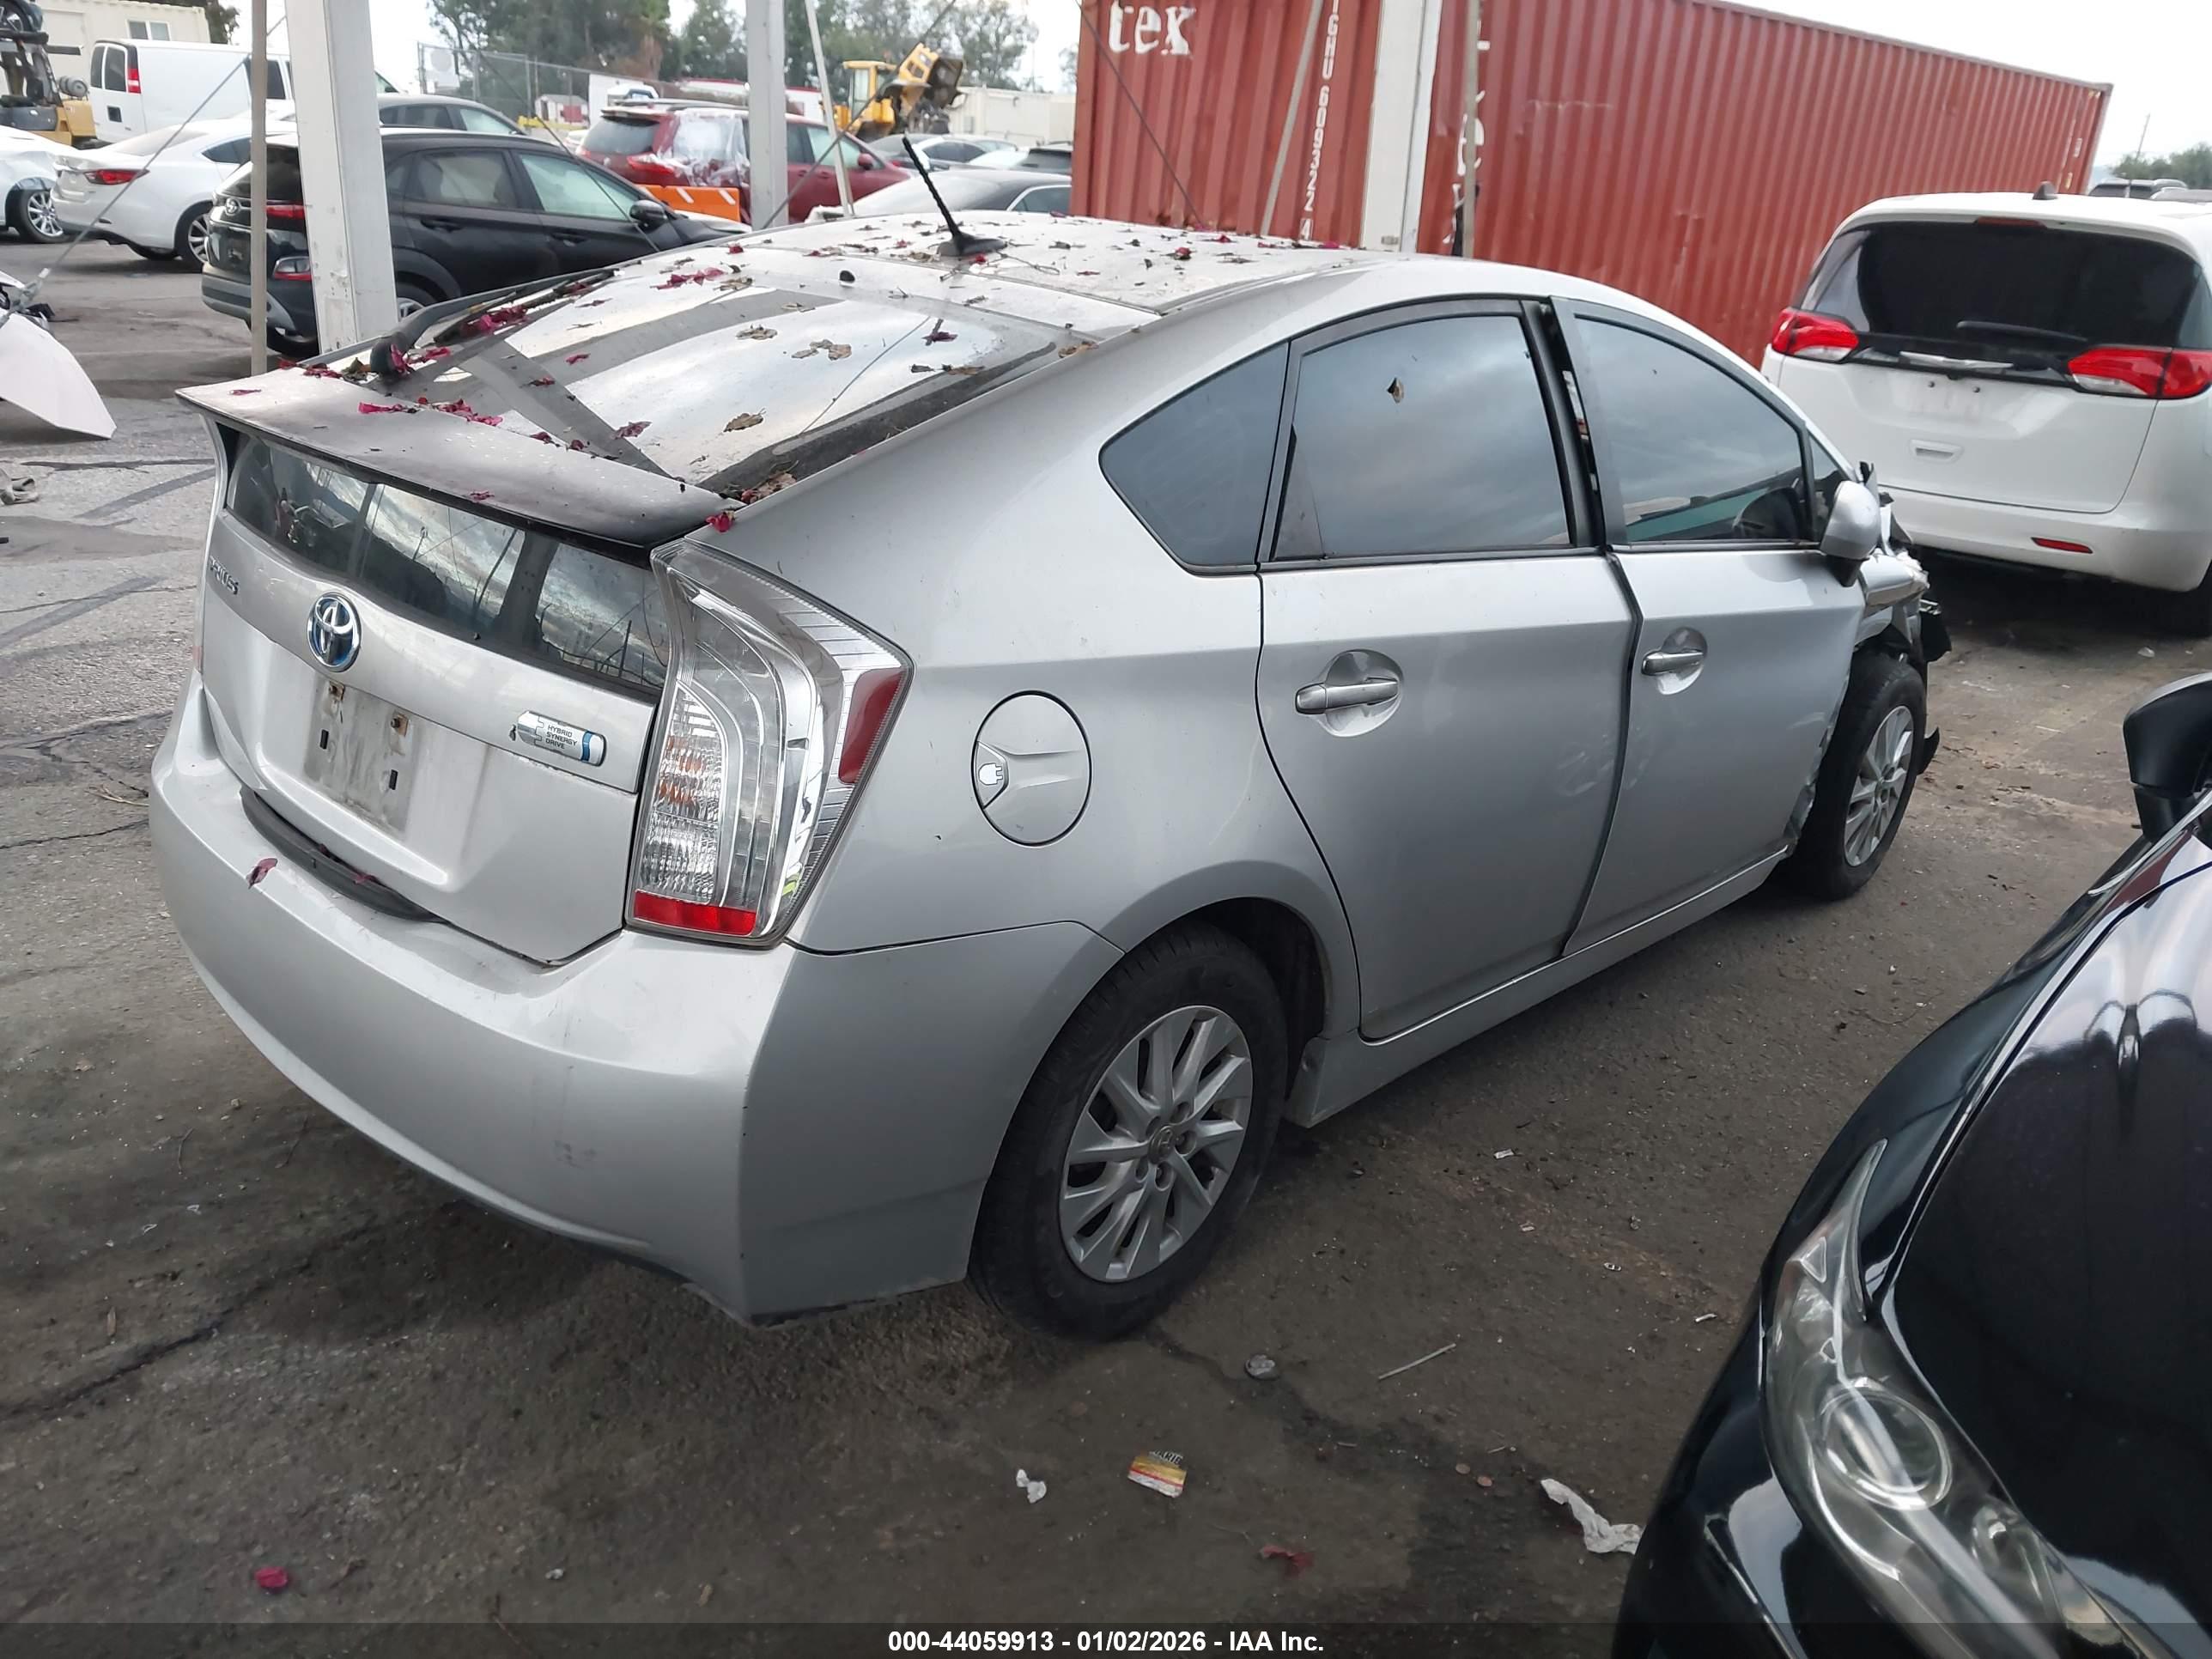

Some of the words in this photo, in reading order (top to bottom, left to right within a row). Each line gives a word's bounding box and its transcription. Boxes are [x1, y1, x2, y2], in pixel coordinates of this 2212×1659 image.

[1109, 0, 1197, 55] tex
[547, 725, 573, 738] HYBRID
[545, 738, 566, 750] DRIVE
[546, 732, 578, 747] SYNERGY
